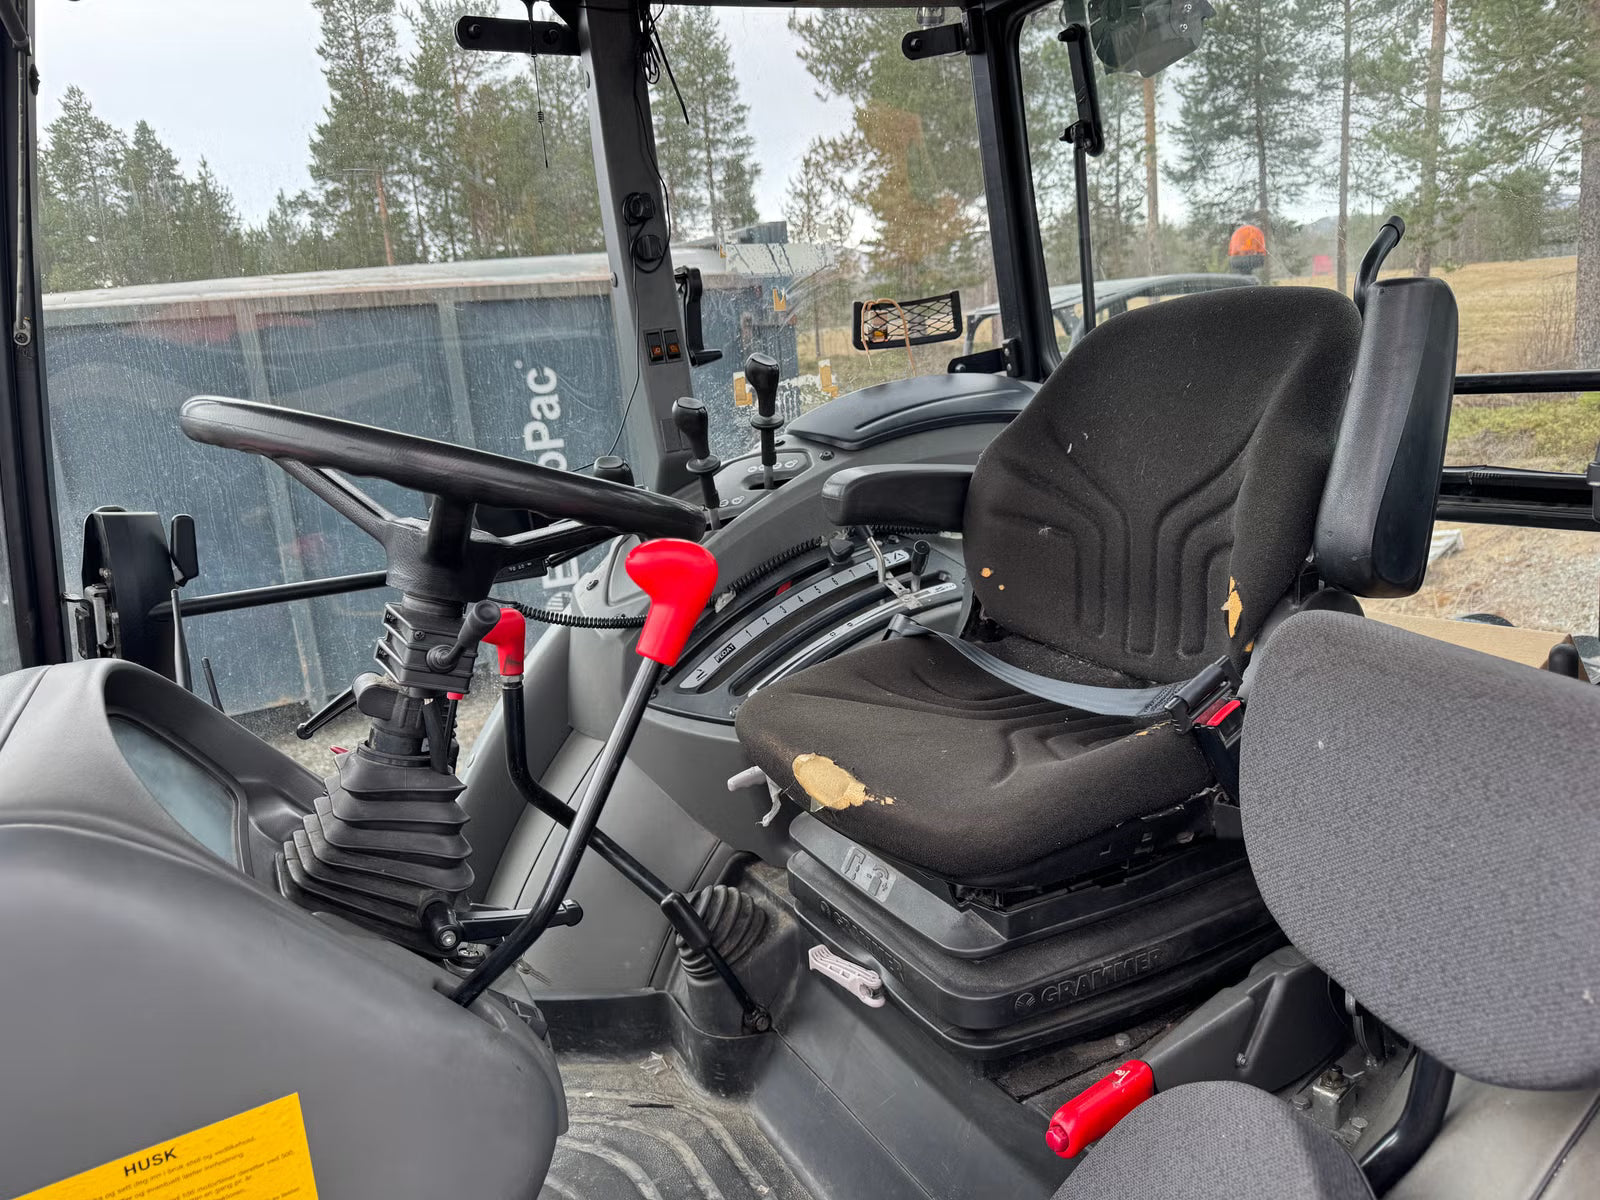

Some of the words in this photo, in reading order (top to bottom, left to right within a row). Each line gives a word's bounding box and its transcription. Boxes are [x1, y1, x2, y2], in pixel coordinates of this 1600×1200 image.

[714, 643, 736, 662] FLOAT
[762, 616, 770, 626] 2
[779, 605, 788, 614] 3
[1041, 948, 1161, 1003] GRAMMER
[124, 1147, 177, 1177] HUSK
